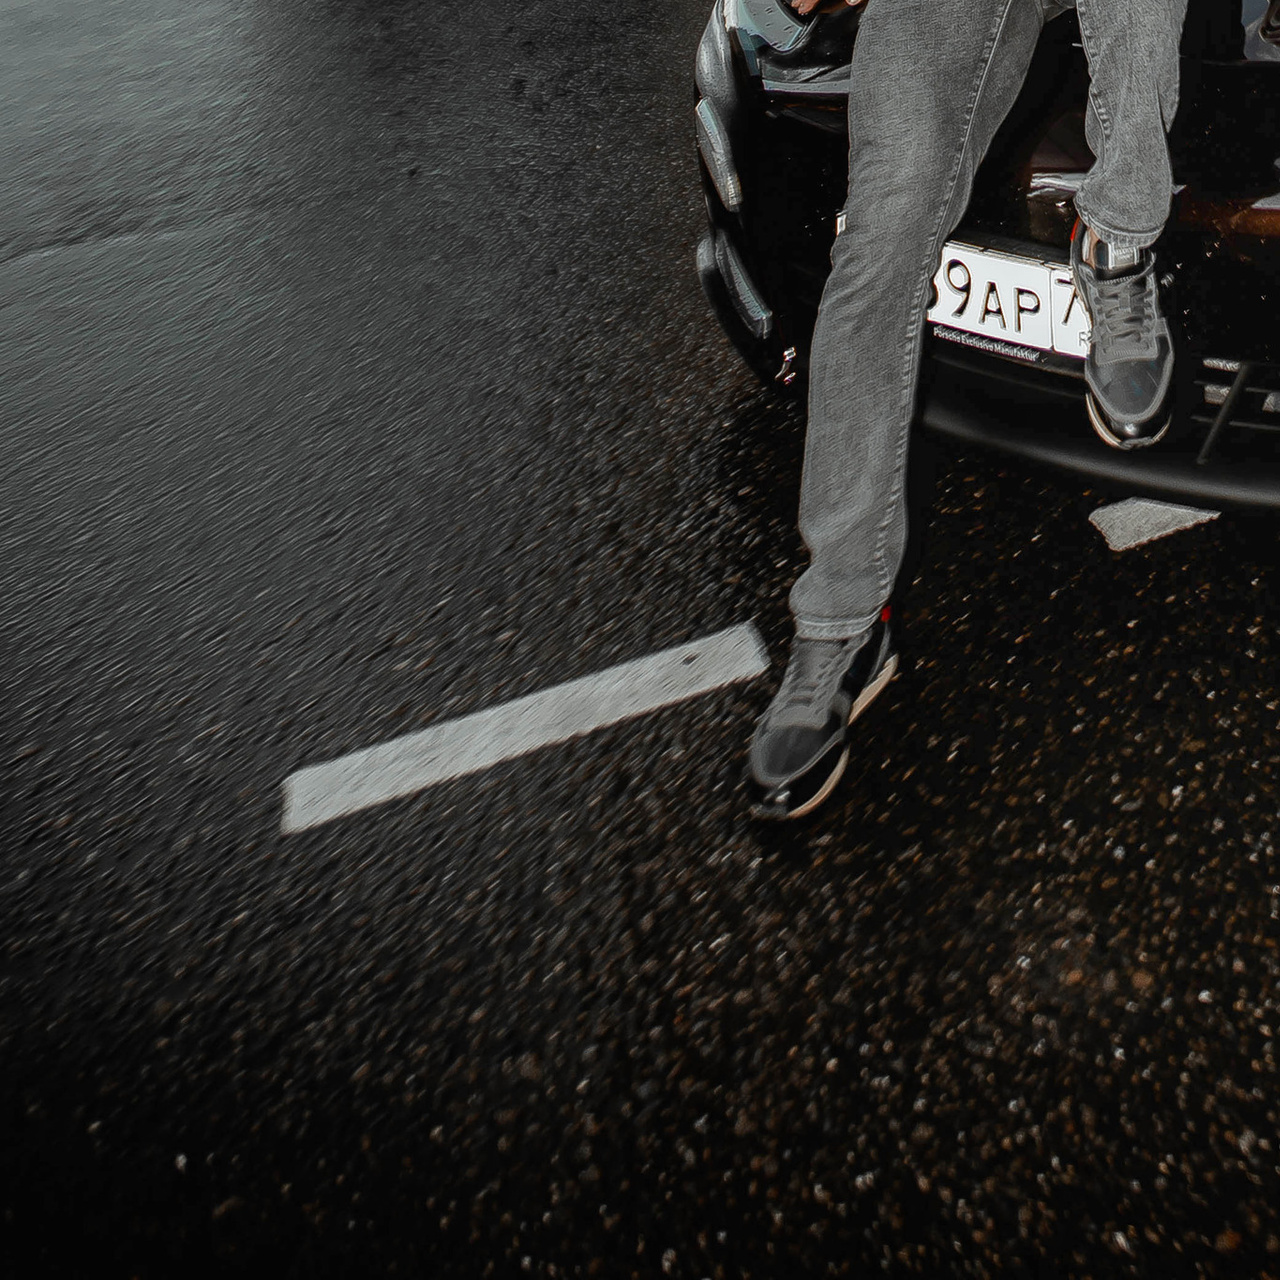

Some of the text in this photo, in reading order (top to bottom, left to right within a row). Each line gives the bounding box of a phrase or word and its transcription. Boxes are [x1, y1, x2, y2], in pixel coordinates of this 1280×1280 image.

[929, 258, 1041, 333] 9AP
[933, 326, 1039, 362] Porsche Exclusive Manufaktur
